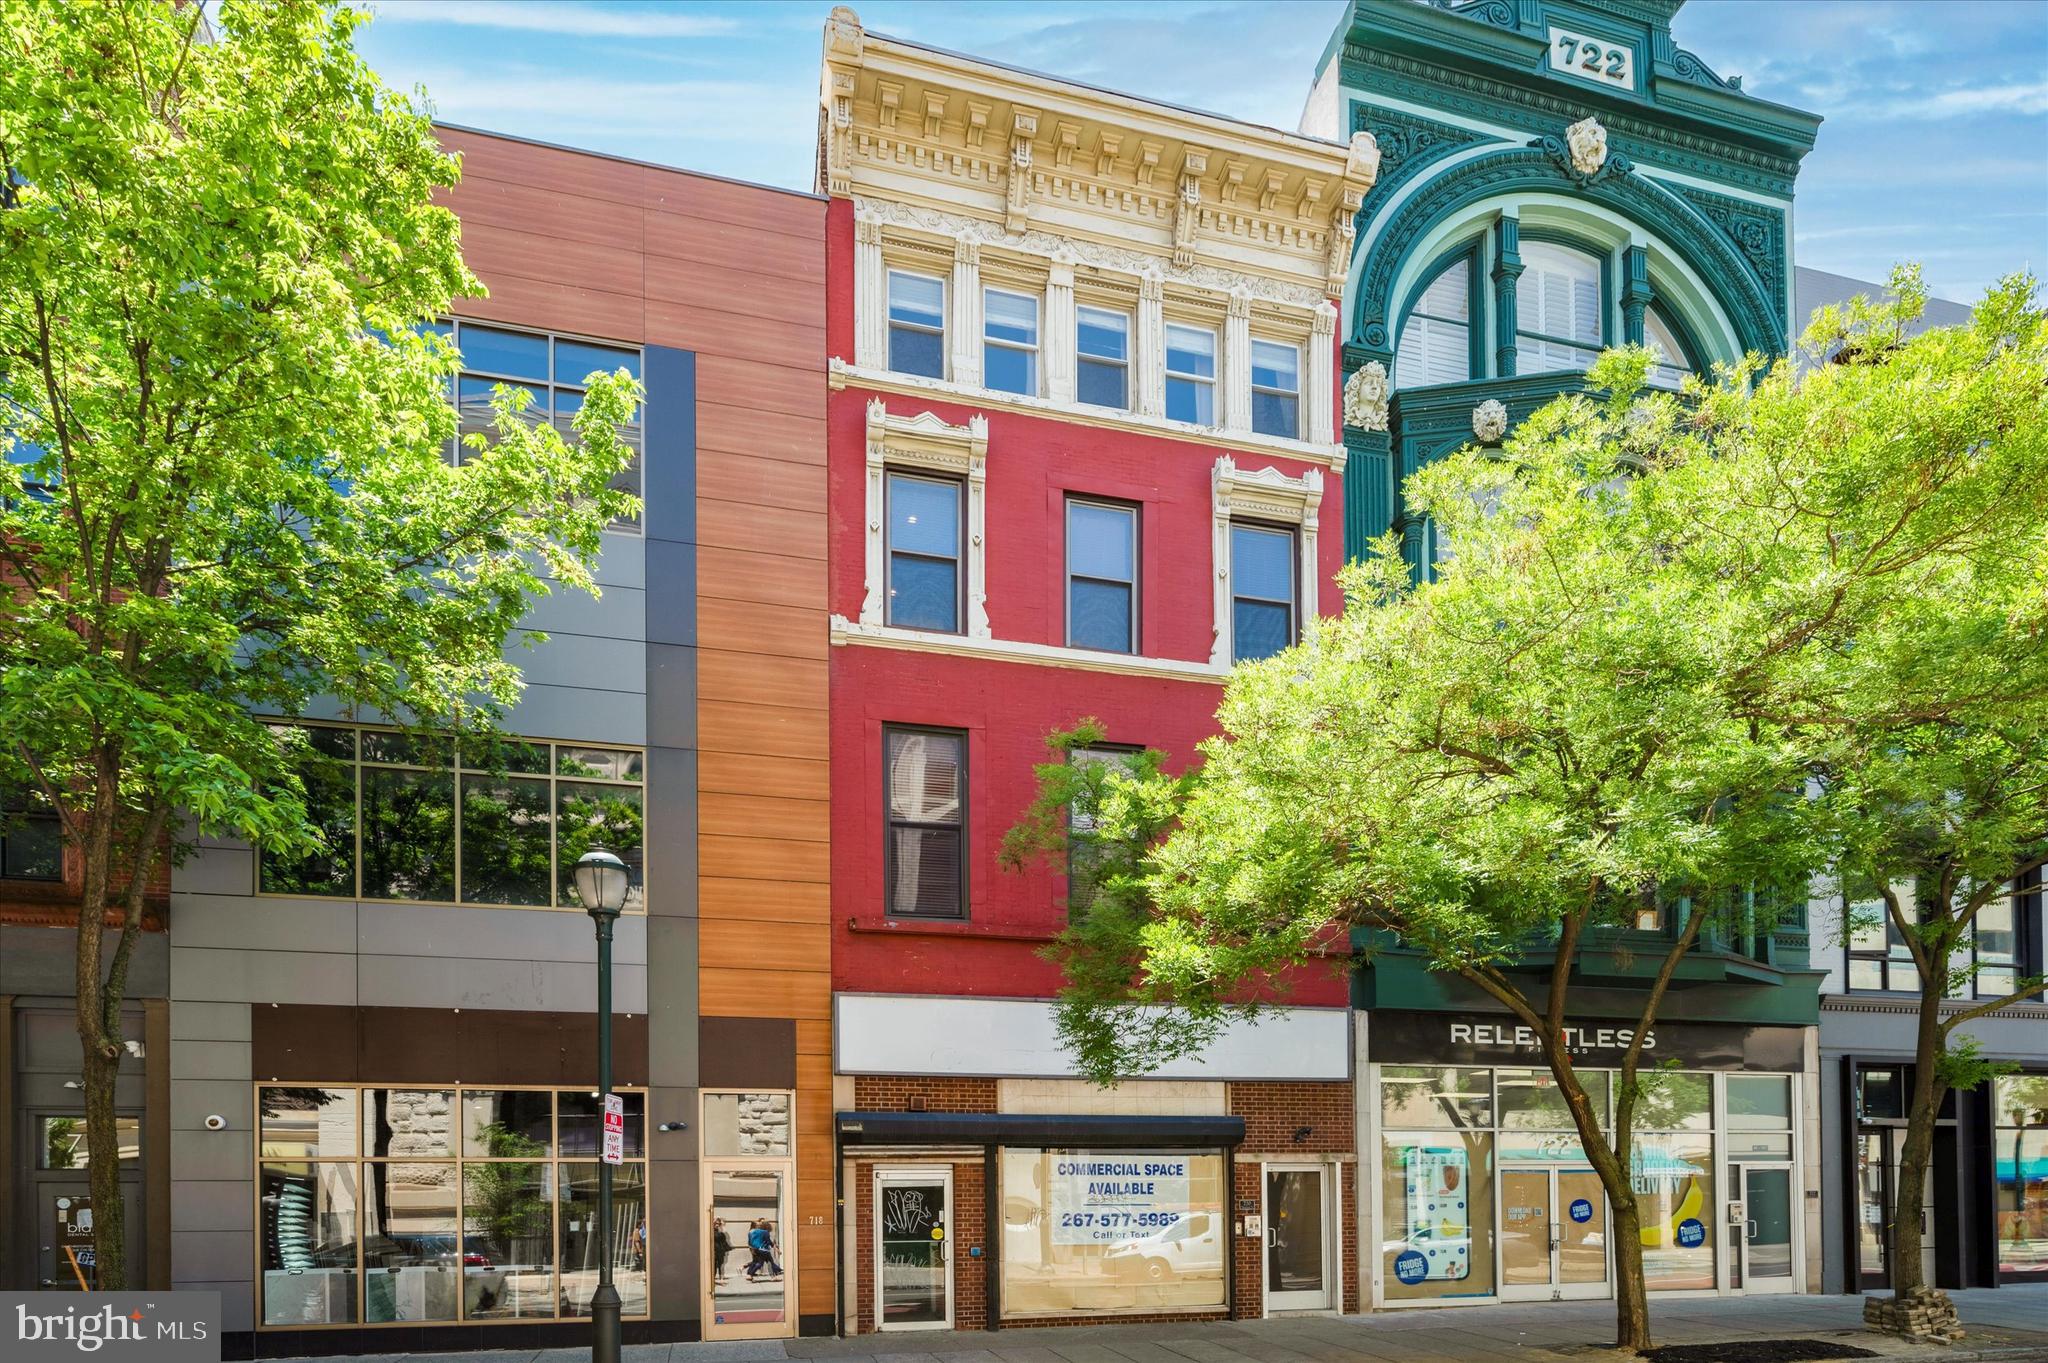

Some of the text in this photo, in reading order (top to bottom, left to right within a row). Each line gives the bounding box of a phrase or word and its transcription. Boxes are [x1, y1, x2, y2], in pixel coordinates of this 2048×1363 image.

[1559, 36, 1626, 80] 722
[1450, 1024, 1656, 1049] RELETLESS
[1528, 1046, 1588, 1055] FIESS
[610, 1114, 618, 1125] NO
[608, 1134, 620, 1144] ANY
[607, 1143, 620, 1154] TIME
[1057, 1163, 1184, 1176] COMMERCIAL SPACE
[1088, 1182, 1155, 1195] AVAILABLE
[1572, 1203, 1589, 1213] FRIDGE
[809, 1215, 824, 1225] 718
[1093, 1231, 1113, 1239] Call
[1130, 1231, 1150, 1239] Text
[1680, 1224, 1701, 1236] FRIDGE
[1688, 1233, 1702, 1242] MORE
[1398, 1257, 1424, 1270] FRIDGE
[1400, 1266, 1425, 1279] NO MORE
